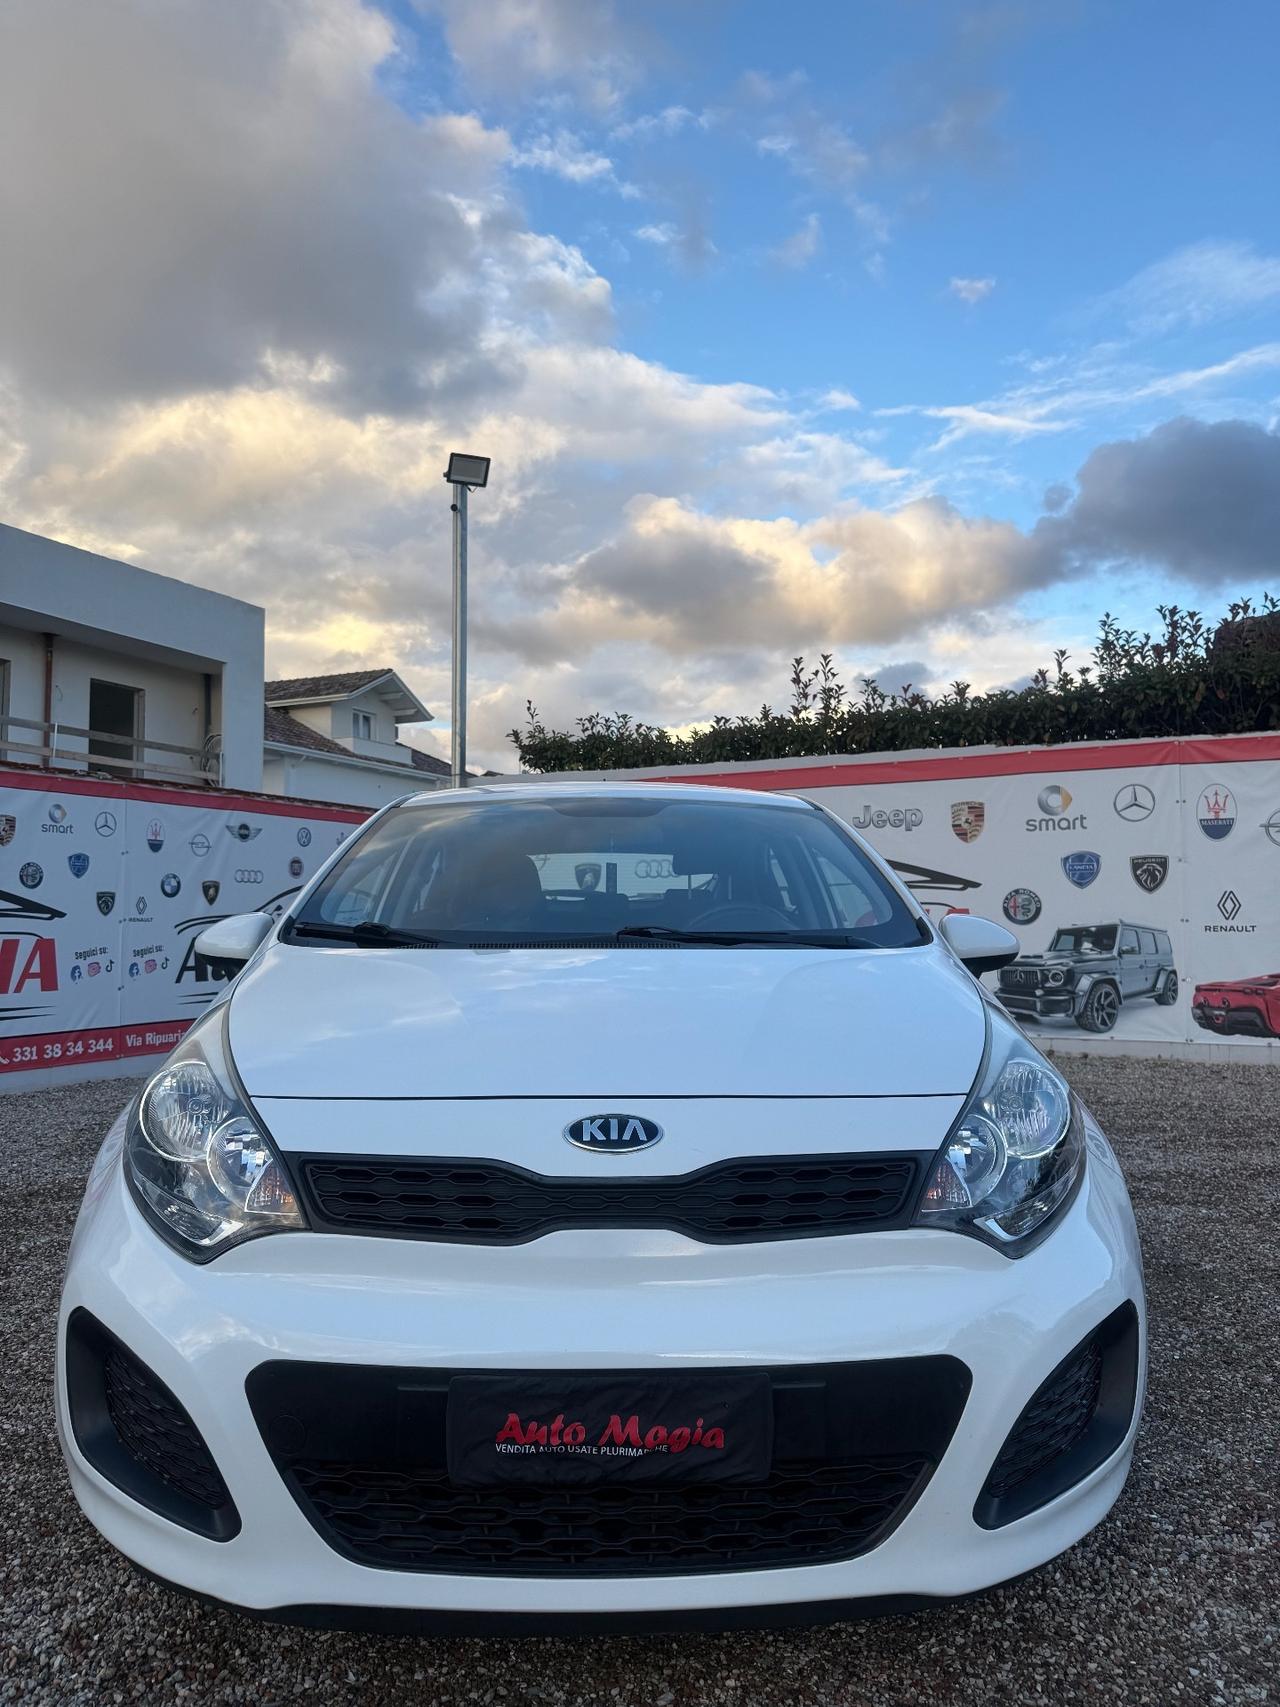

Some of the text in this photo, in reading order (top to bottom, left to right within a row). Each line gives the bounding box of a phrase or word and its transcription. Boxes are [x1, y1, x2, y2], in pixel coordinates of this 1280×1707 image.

[852, 805, 924, 832] Jeep
[1025, 814, 1088, 832] smart
[41, 823, 74, 834] smart
[1204, 924, 1257, 933] RENAULT
[13, 1037, 114, 1062] 331 38 34 344
[126, 1034, 142, 1047] Via
[581, 1118, 648, 1141] KIA
[496, 1413, 725, 1452] Auto Magia
[496, 1443, 669, 1457] VENDITA AUTO USATE PLURIMAHE
